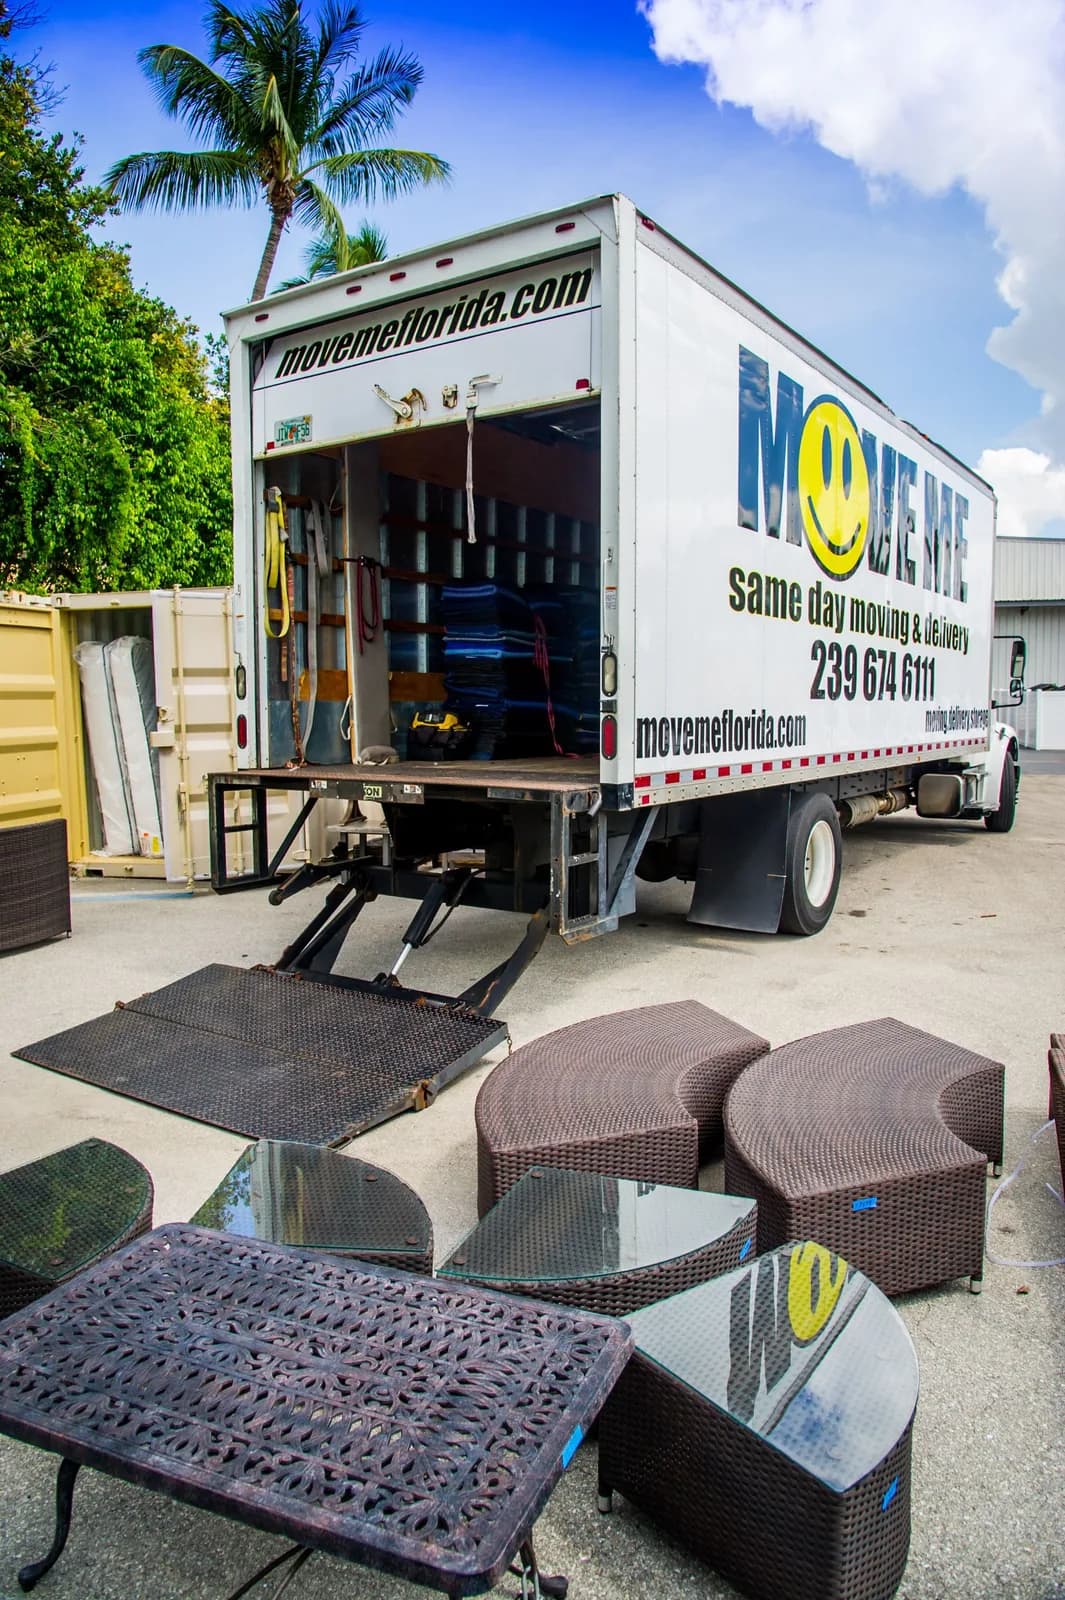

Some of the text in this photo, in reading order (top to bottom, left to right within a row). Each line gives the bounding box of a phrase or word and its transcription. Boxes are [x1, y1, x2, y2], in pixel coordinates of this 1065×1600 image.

[274, 267, 593, 379] movemeflorida.com
[923, 470, 969, 604] ME
[808, 580, 846, 634] day
[850, 596, 909, 646] moving
[912, 612, 922, 645] &
[924, 612, 970, 656] delivery
[810, 639, 936, 701] 239 674 6111
[636, 709, 807, 759] movemeflorida.com
